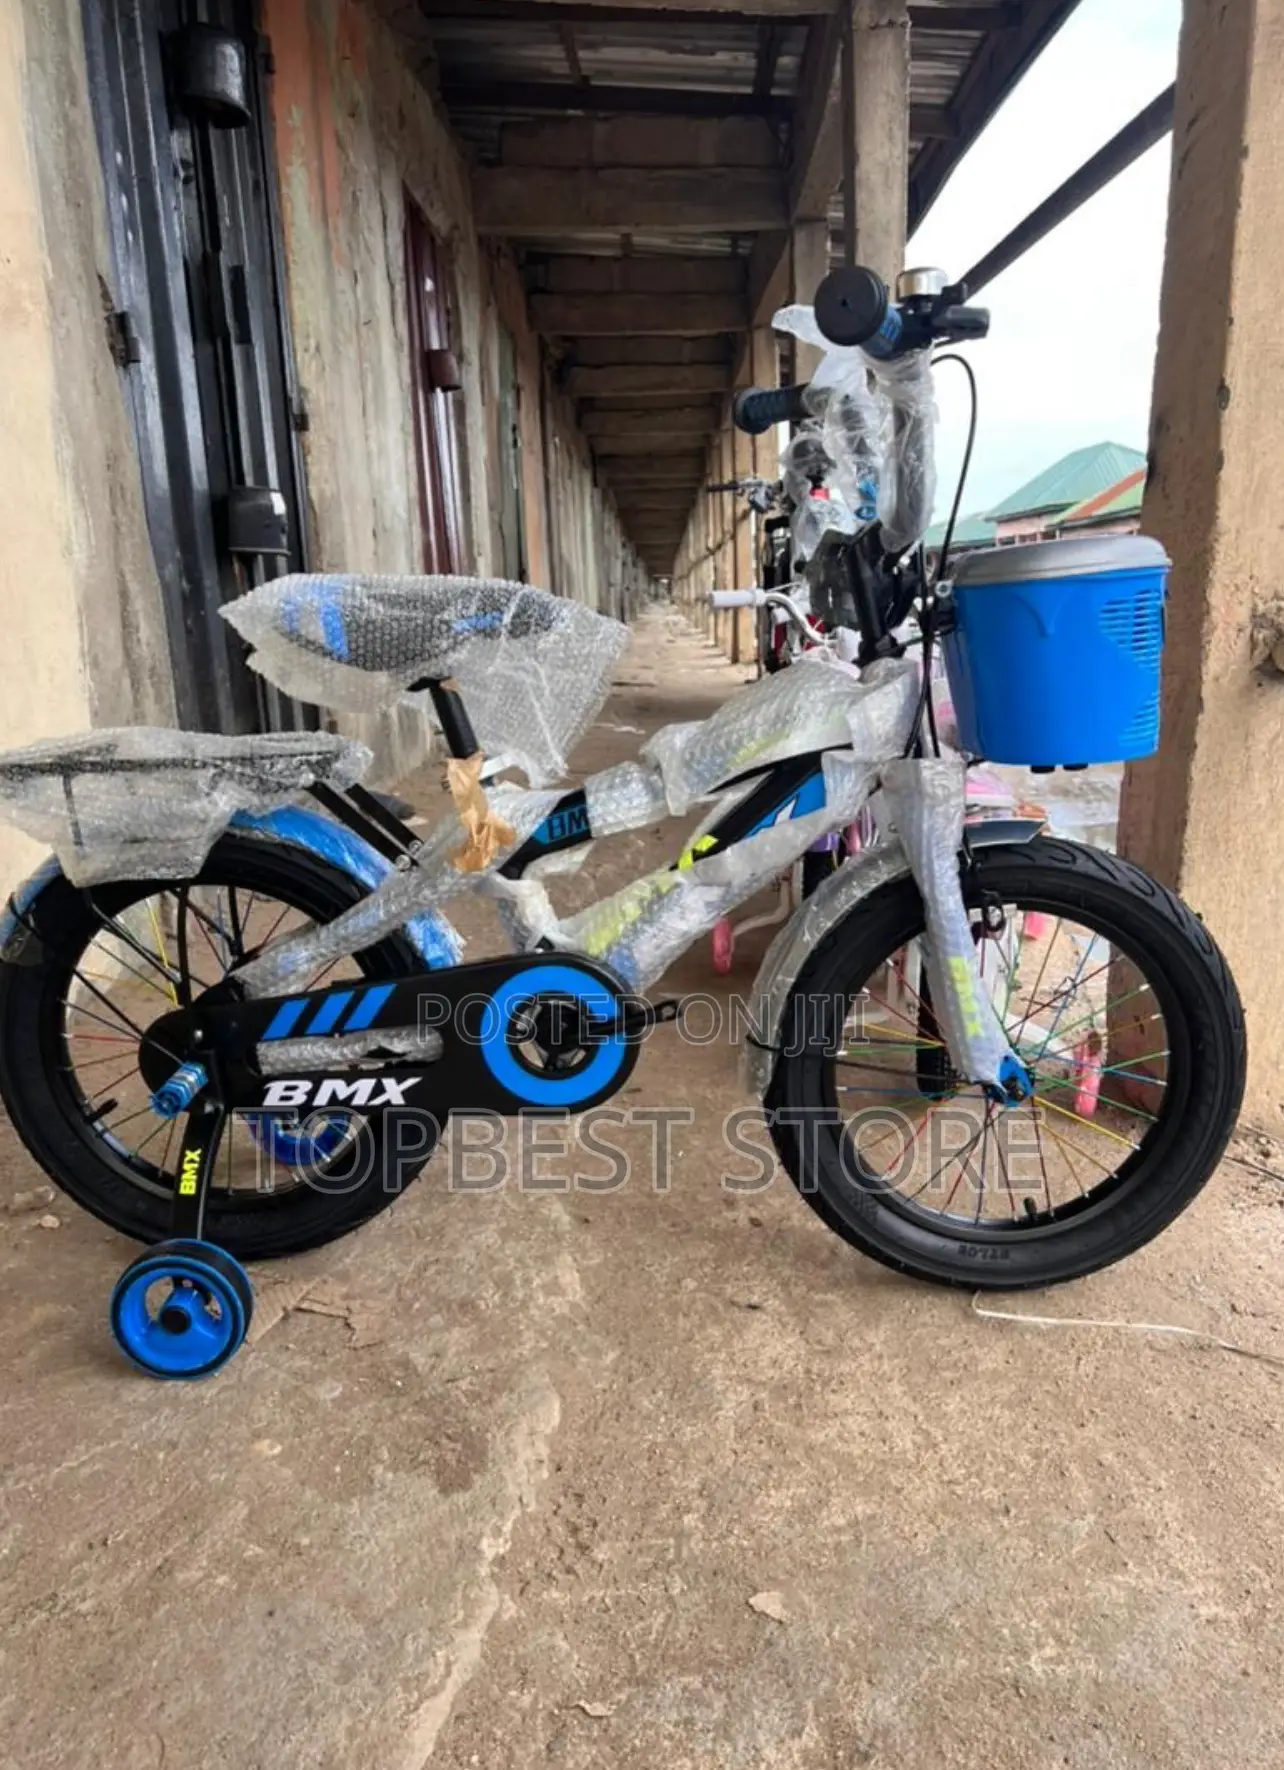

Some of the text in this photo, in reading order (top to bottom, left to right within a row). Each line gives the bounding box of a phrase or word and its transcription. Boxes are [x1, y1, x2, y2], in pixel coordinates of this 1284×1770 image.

[547, 805, 591, 840] BM
[262, 1076, 423, 1107] BMX
[178, 1148, 202, 1196] BMX
